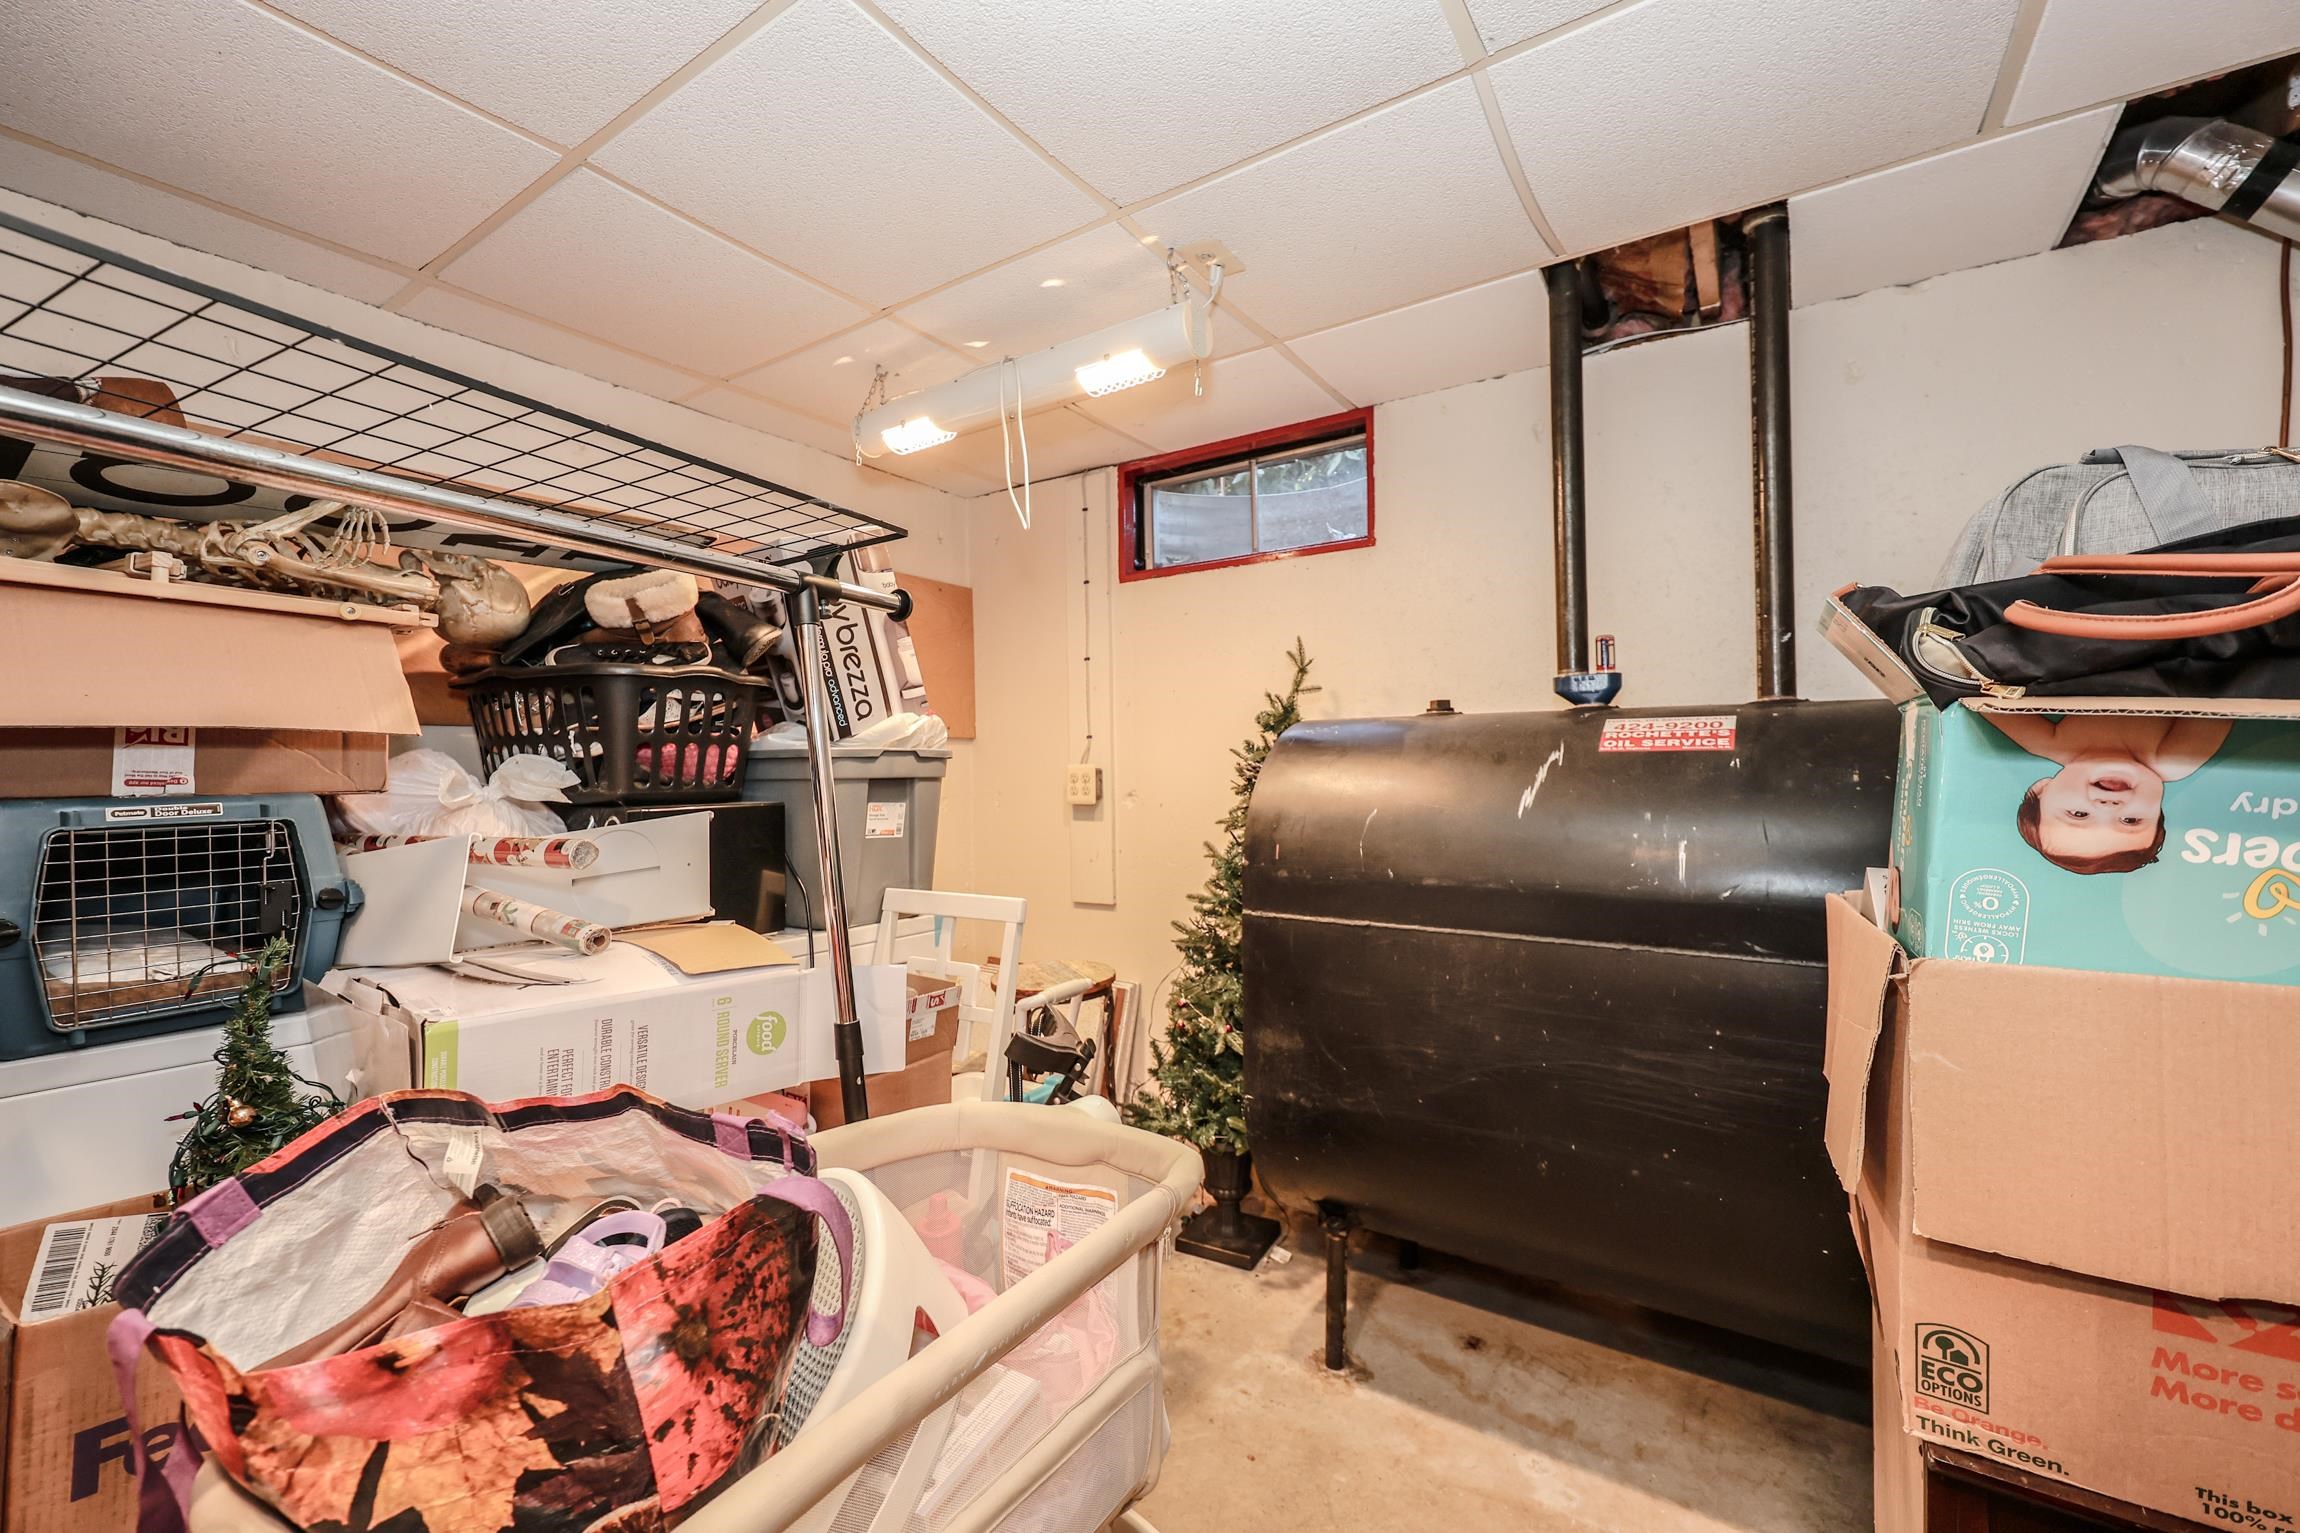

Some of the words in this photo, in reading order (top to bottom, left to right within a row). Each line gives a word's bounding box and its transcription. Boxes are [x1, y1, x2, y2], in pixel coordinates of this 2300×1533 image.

[828, 679, 848, 728] advanced
[1605, 729, 1731, 739] ROCHETTE'S
[1614, 721, 1723, 731] 424-9200
[1641, 737, 1730, 747] SERVICE
[155, 809, 179, 817] Door
[180, 808, 213, 816] Deluxe
[2229, 791, 2298, 820] dry
[1953, 918, 1971, 926] SKIN
[1953, 924, 1989, 934] WETNESS
[1973, 919, 1996, 929] FROM
[1991, 929, 2019, 938] LOCKS
[716, 996, 733, 1006] 6
[600, 1018, 613, 1053] DURABLE
[636, 1024, 649, 1065] VERSATILE
[716, 1011, 731, 1048] ROUND
[755, 1014, 779, 1053] food
[561, 1048, 574, 1082] PERFECT
[714, 1048, 730, 1089] SERVER
[1034, 1207, 1056, 1218] HAZARD
[1921, 1359, 1983, 1393] ECO
[2151, 1346, 2264, 1393] More
[1920, 1379, 1982, 1407] OPTIONS
[2150, 1375, 2263, 1422] More
[1913, 1396, 1945, 1416] Be
[1951, 1408, 2049, 1451] Orange.
[1915, 1414, 1981, 1447] Think
[1987, 1439, 2070, 1476] Green.
[2194, 1486, 2240, 1509] This
[2246, 1501, 2294, 1524] box
[2202, 1502, 2268, 1532] 100%
